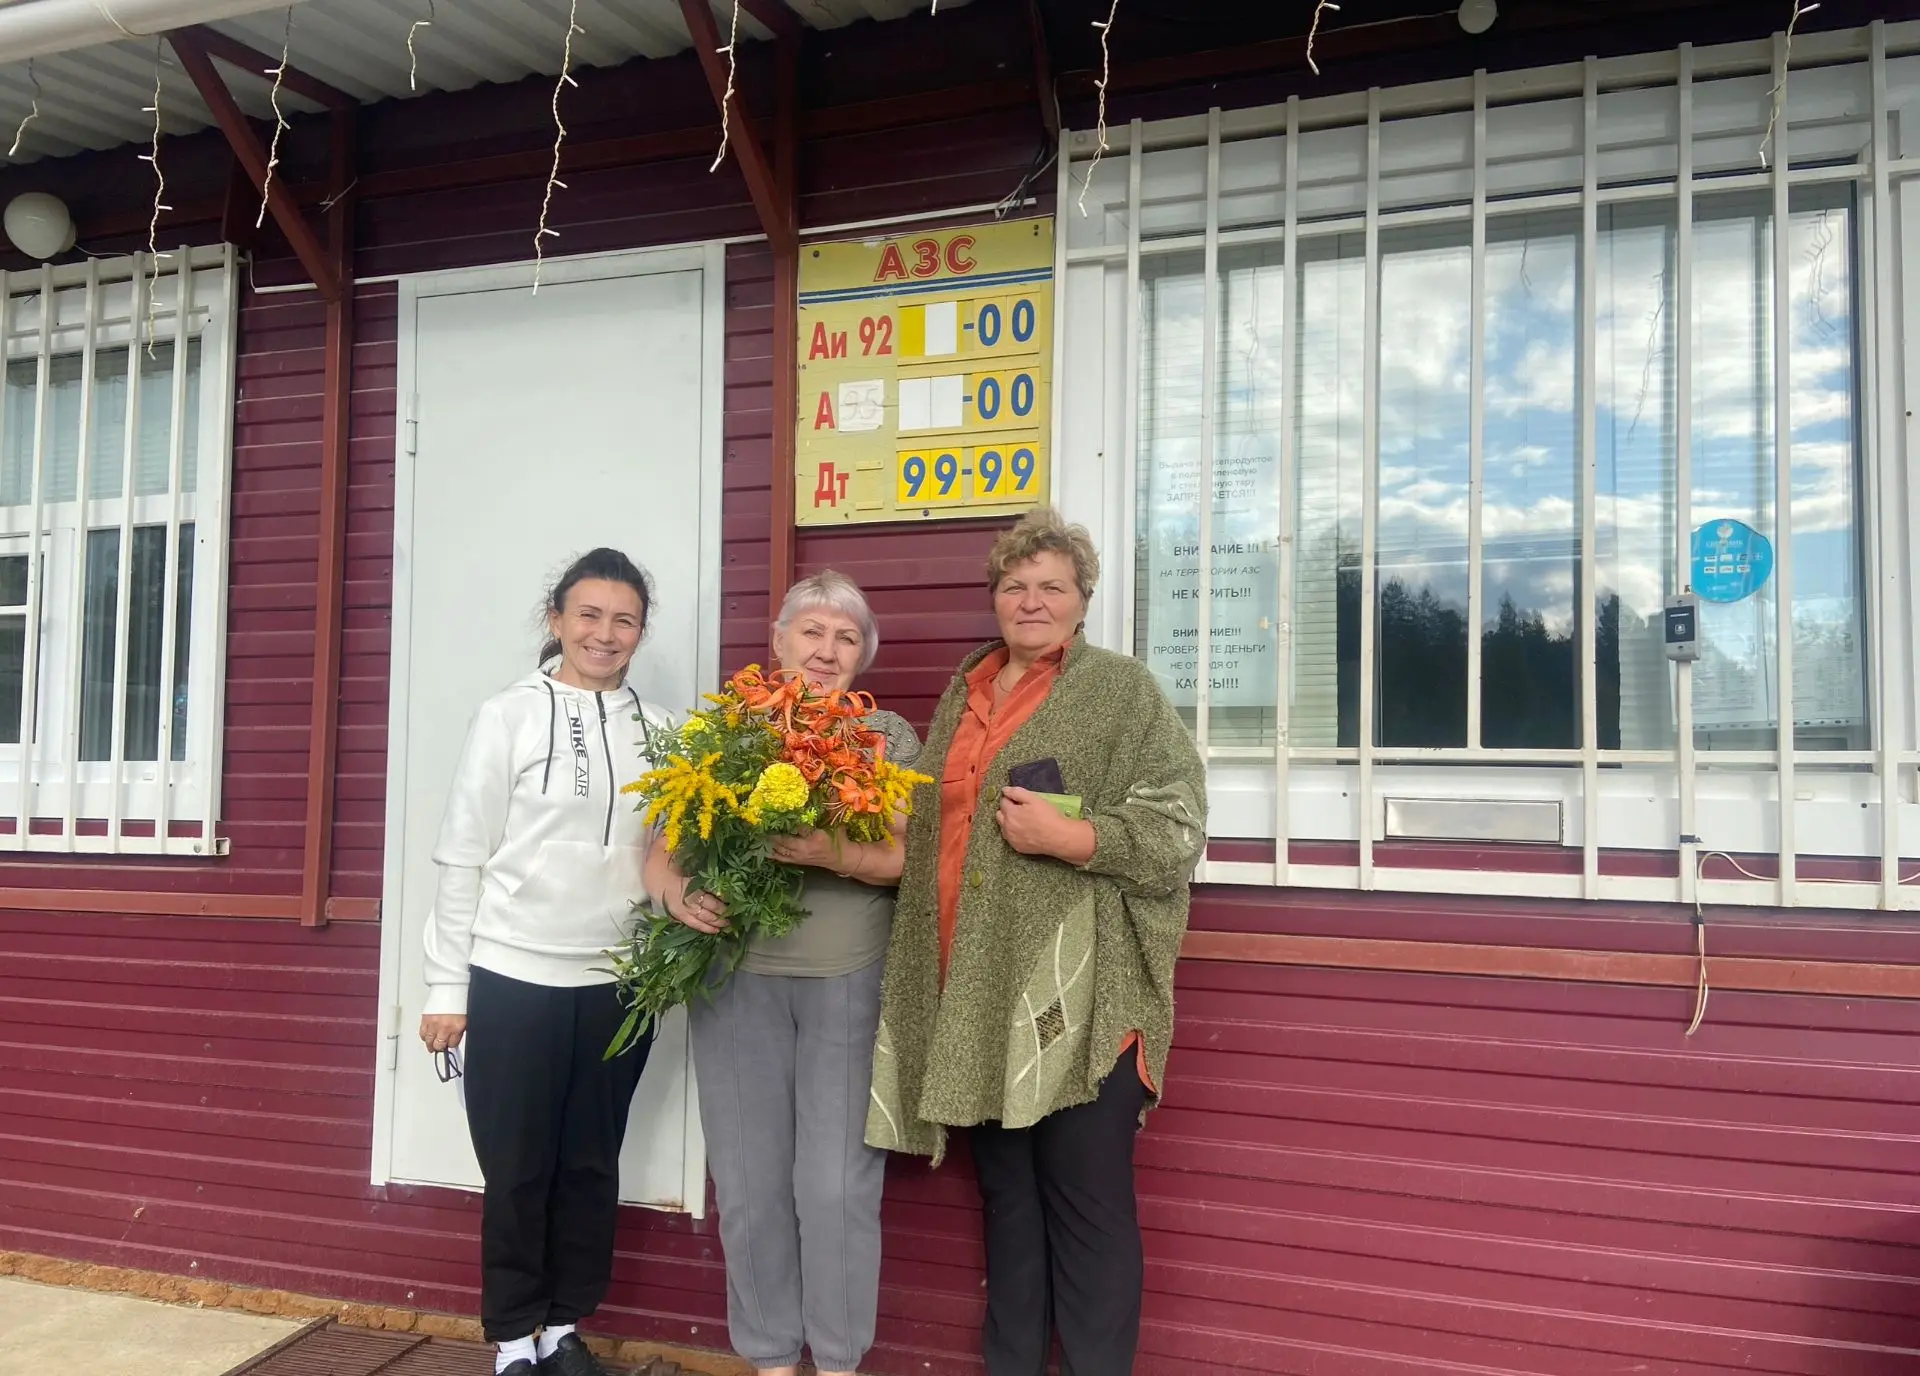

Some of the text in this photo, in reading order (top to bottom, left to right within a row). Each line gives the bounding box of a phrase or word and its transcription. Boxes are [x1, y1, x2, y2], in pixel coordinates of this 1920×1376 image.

[873, 235, 977, 282] АЗС
[808, 315, 893, 361] Аи 92
[903, 447, 1035, 498] 99-99
[814, 461, 850, 508] Дт
[1166, 489, 1257, 503] ЗАПРЕАЕТСЯ!!!
[1173, 543, 1243, 556] ВНИАНИЕ
[1160, 565, 1262, 578] НА ТЕРРОРИИ АЗС
[1172, 588, 1188, 600] НЕ
[1153, 643, 1266, 655] ПРОВЕРЯТЕ ДЕНЬГИ
[1170, 661, 1183, 670] НЕ
[1225, 660, 1239, 670] ОТ
[570, 717, 588, 798] NIKE AIR
